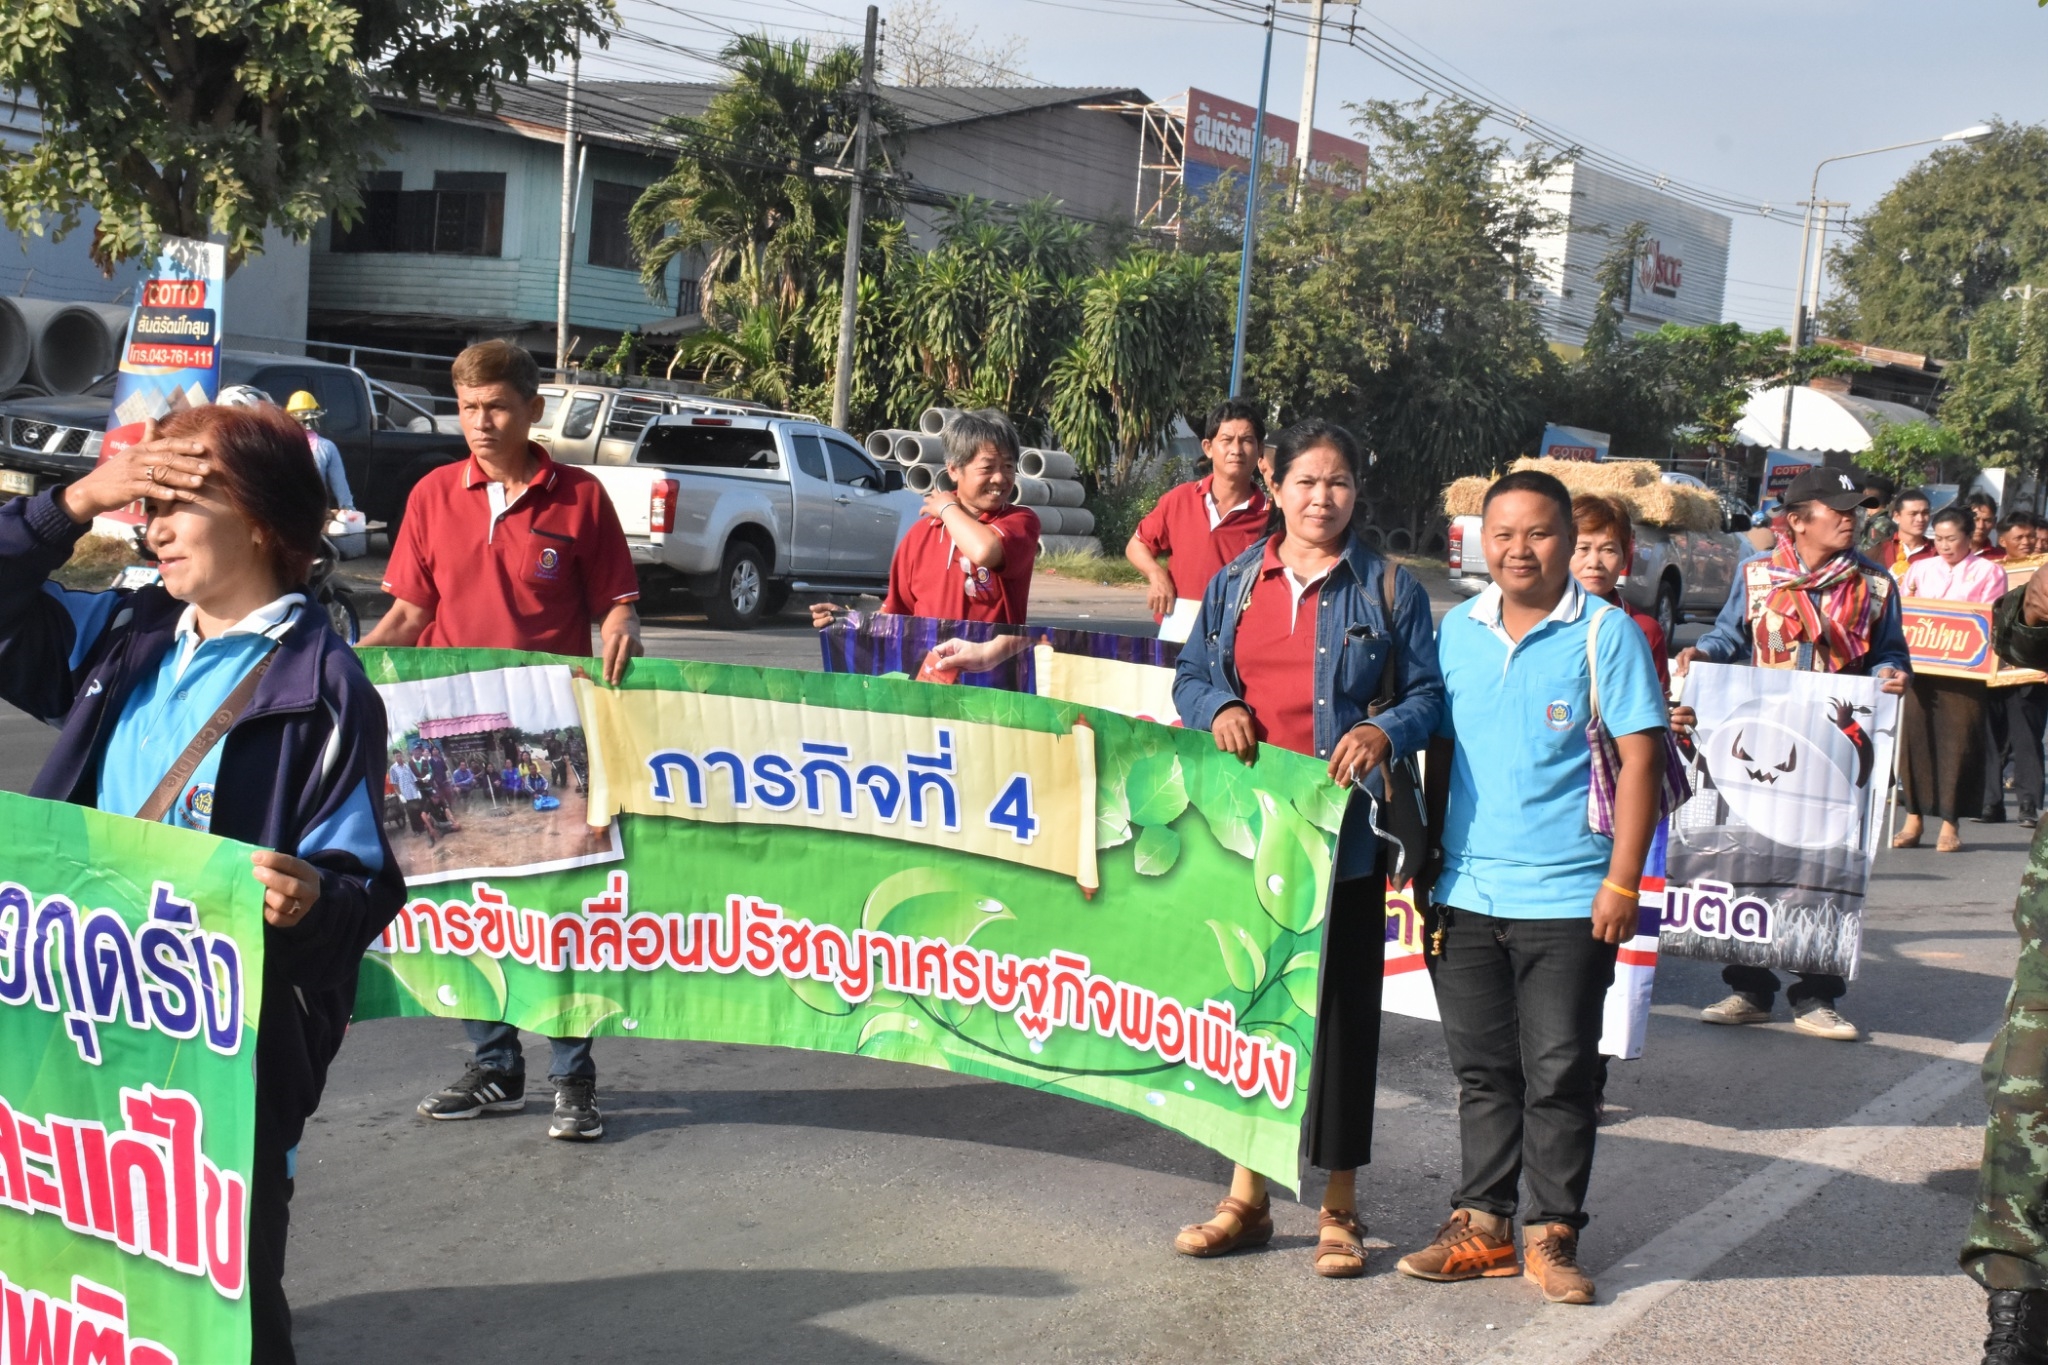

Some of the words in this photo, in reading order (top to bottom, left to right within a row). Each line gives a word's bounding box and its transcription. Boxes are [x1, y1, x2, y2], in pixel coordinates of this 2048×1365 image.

[149, 283, 200, 305] COTTO
[1552, 446, 1593, 458] COTTO
[648, 729, 958, 829] ภารกิจที่
[988, 776, 1036, 840] 4
